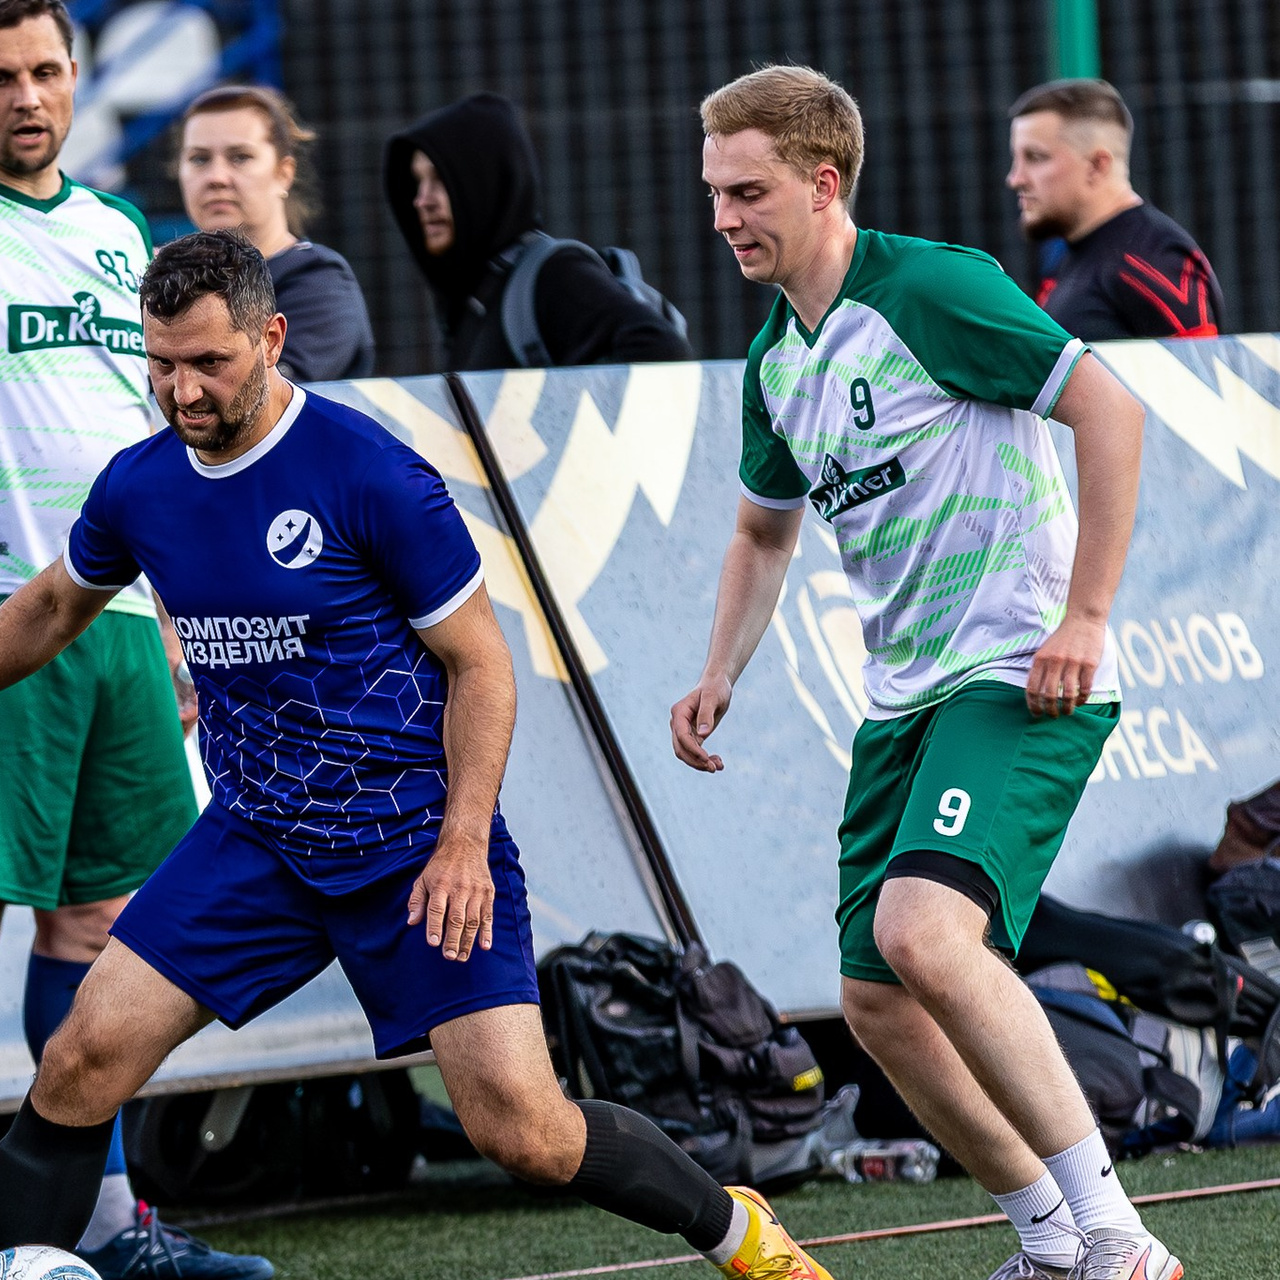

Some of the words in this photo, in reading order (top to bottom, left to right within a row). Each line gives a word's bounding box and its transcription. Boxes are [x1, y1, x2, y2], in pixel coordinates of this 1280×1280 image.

[850, 377, 876, 431] 9
[181, 637, 306, 669] ИЗДЕЛИЯ
[1114, 612, 1265, 689] ОНОВ
[1088, 706, 1219, 784] НЕСА
[933, 788, 972, 837] 9
